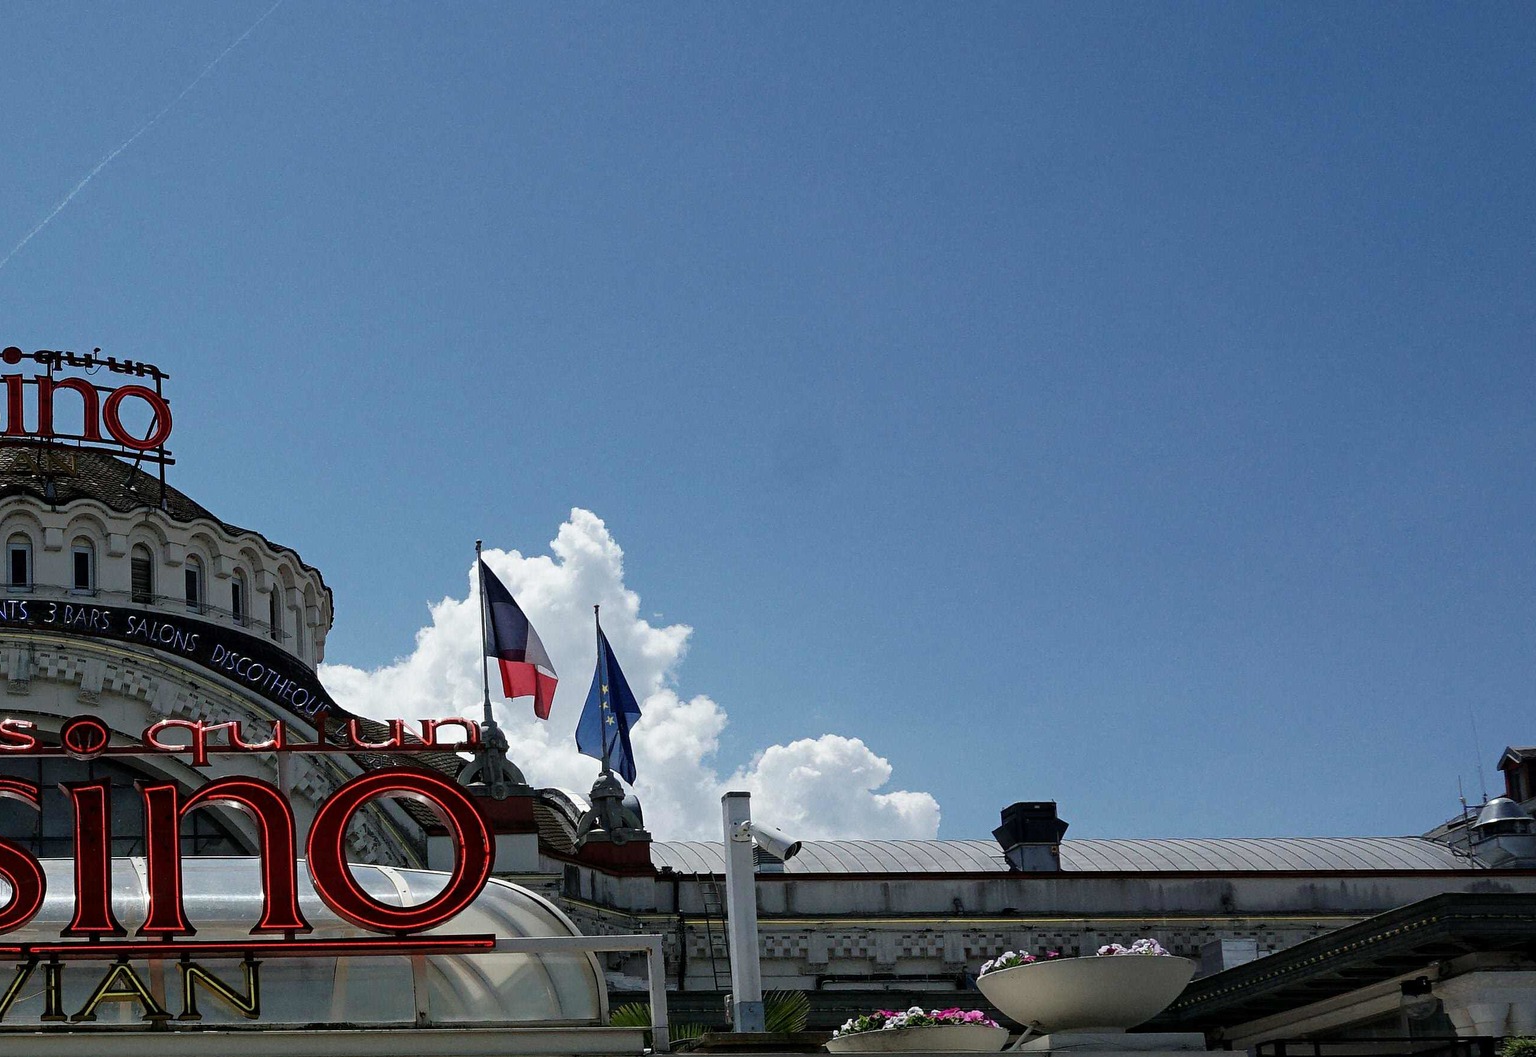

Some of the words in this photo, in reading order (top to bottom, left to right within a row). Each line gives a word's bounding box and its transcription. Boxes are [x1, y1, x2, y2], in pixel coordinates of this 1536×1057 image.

[44, 602, 58, 624] 3
[63, 603, 112, 631] BARS
[126, 614, 201, 653] SALONS
